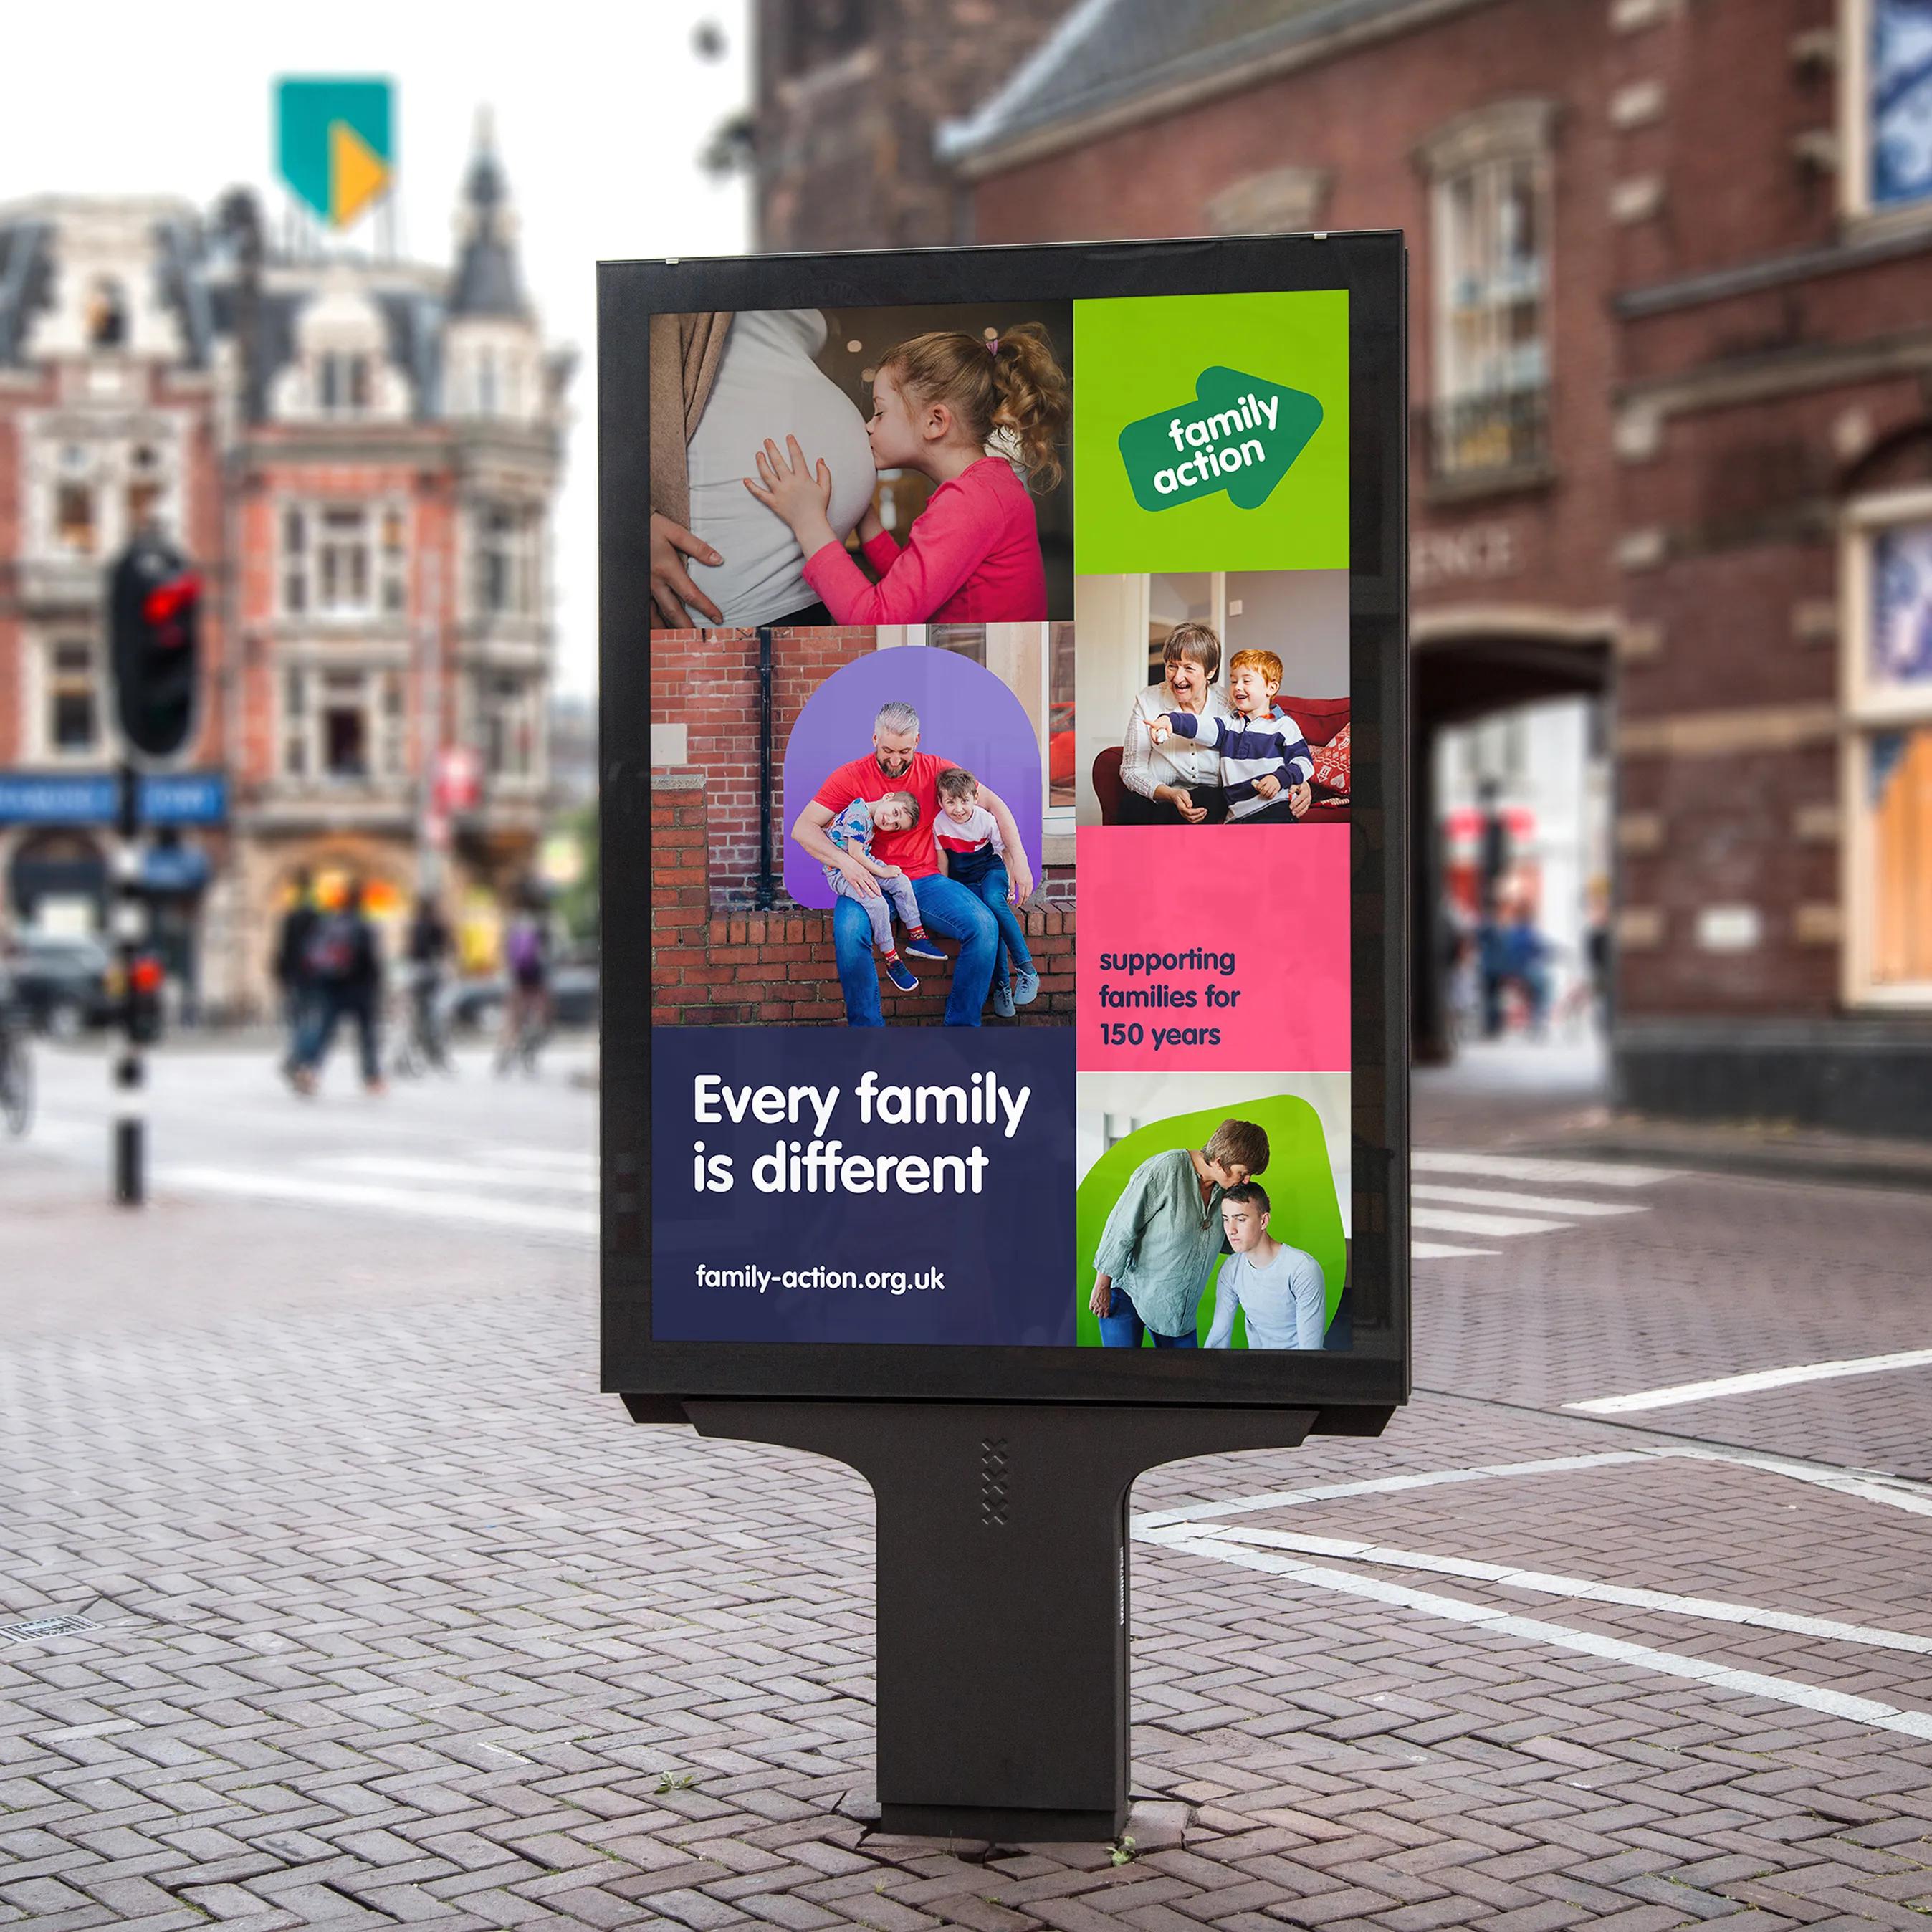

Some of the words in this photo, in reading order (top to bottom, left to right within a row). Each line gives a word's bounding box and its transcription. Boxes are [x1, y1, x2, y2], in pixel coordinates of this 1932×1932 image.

[1168, 393, 1279, 452] family
[1153, 444, 1266, 494] action
[1099, 947, 1235, 976] supporting
[1099, 985, 1197, 1008] families
[1205, 984, 1240, 1007] for
[1100, 1023, 1144, 1045] 150
[1152, 1027, 1221, 1051] years
[694, 1074, 841, 1137] Every
[855, 1071, 1031, 1138] family
[694, 1140, 734, 1192] is
[752, 1139, 990, 1194] different
[696, 1264, 945, 1295] family-action.org.uk
